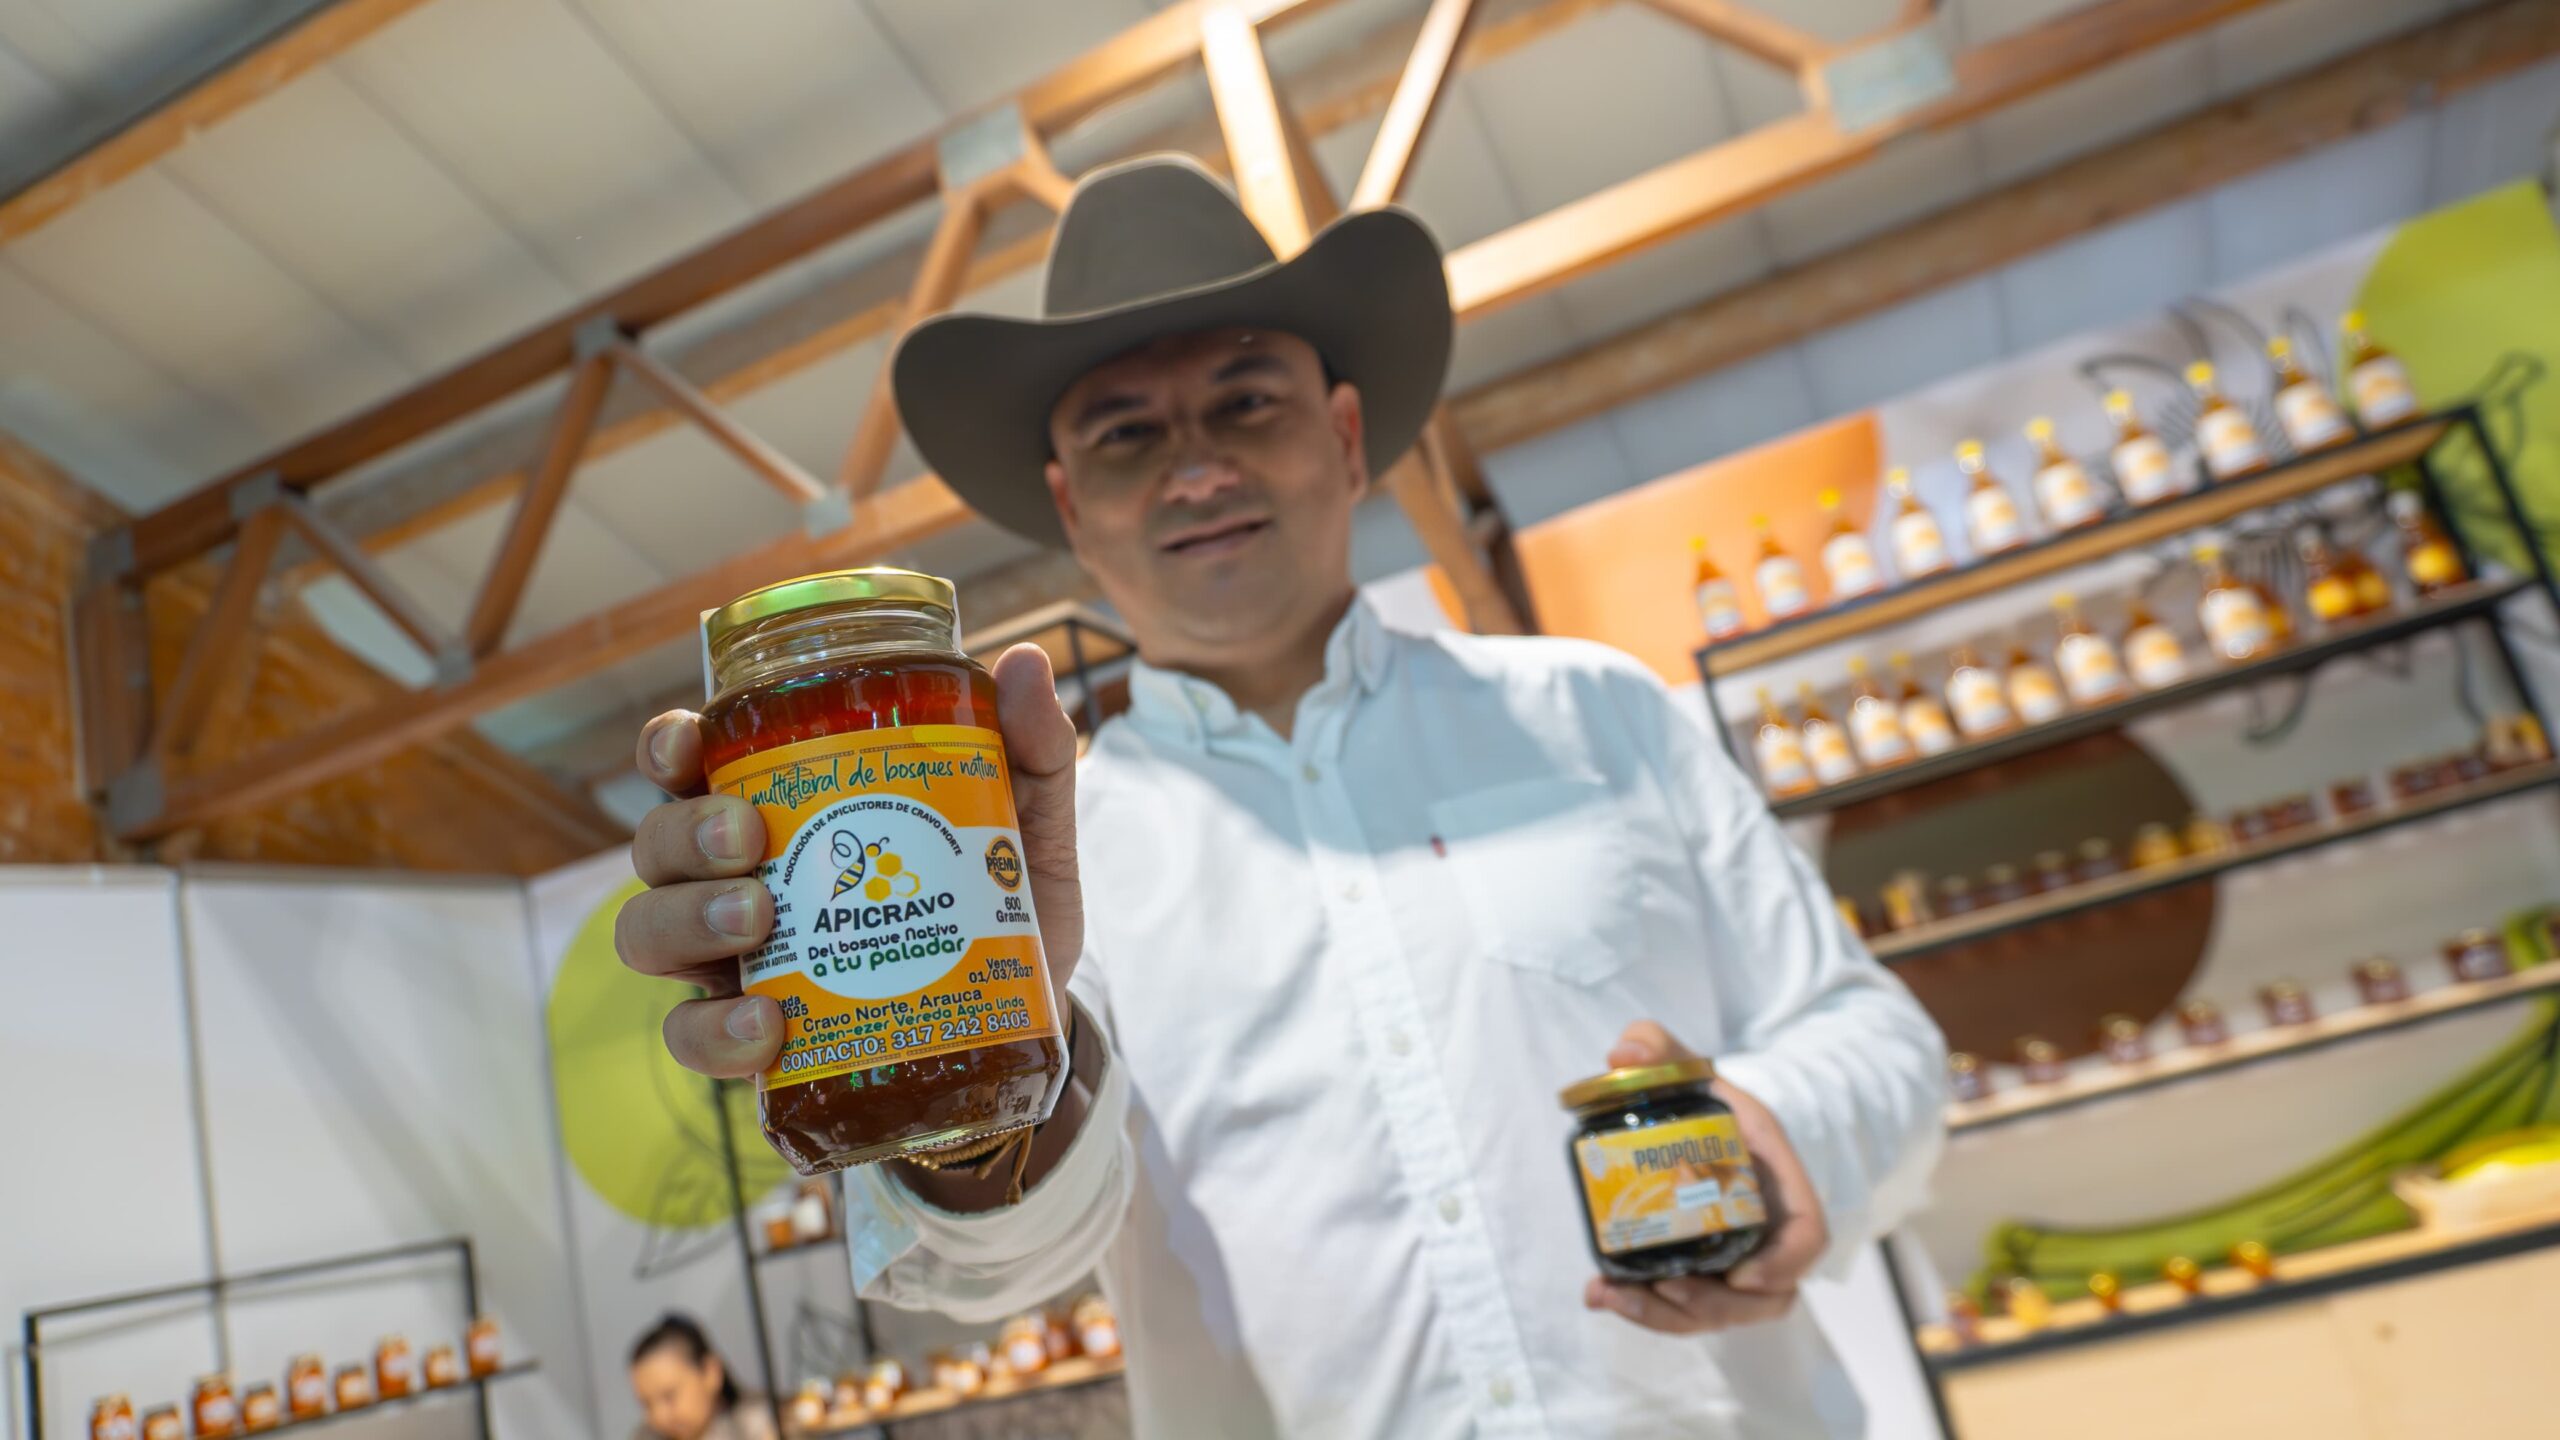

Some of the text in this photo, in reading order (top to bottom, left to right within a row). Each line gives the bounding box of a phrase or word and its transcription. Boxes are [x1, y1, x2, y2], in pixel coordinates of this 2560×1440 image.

[751, 758, 841, 810] multifloral
[848, 756, 877, 790] de
[884, 751, 953, 791] bosques
[783, 800, 963, 886] ASOCIACIÓN DE APICULTORES DE CRAVO NORTE
[813, 892, 955, 934] APICRAVO
[996, 910, 1031, 923] Gramos
[1004, 896, 1022, 911] 600
[808, 922, 958, 960] Del bosque Nativo
[813, 935, 966, 977] a tu paladar
[968, 966, 1034, 984] 01/03/2027
[986, 957, 1021, 970] Vence:
[803, 988, 983, 1033] Cravo Norte, Arauca
[810, 1019, 890, 1046] eben-ezer
[894, 1006, 952, 1027] Vereda
[957, 1001, 993, 1018] Agua
[996, 996, 1025, 1011] linda
[781, 1009, 1031, 1074] CONTACTO: 317 242 8405
